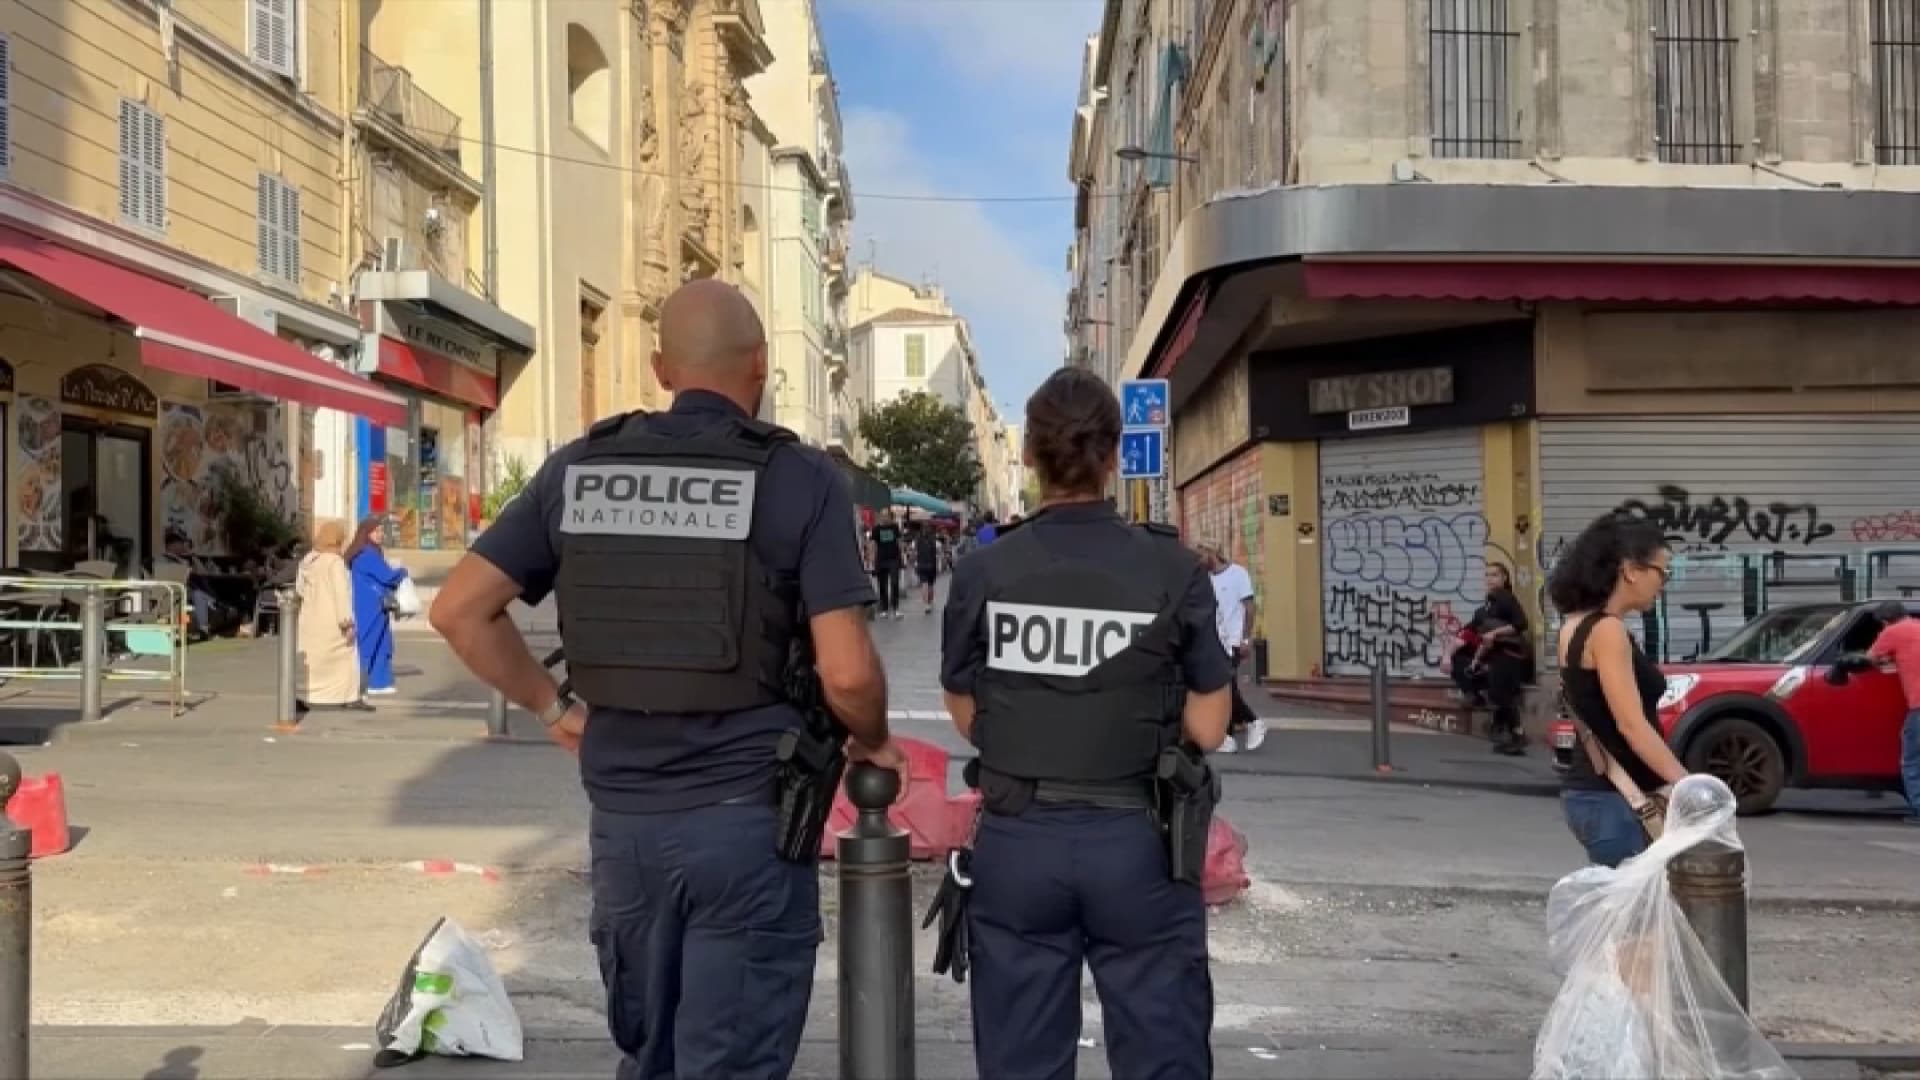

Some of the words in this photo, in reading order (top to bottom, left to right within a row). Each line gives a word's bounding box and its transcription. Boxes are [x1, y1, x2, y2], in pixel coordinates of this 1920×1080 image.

[1313, 377, 1360, 413] MY
[1367, 367, 1452, 408] SHOP
[575, 474, 742, 506] POLICE
[572, 508, 738, 530] NATIONALE
